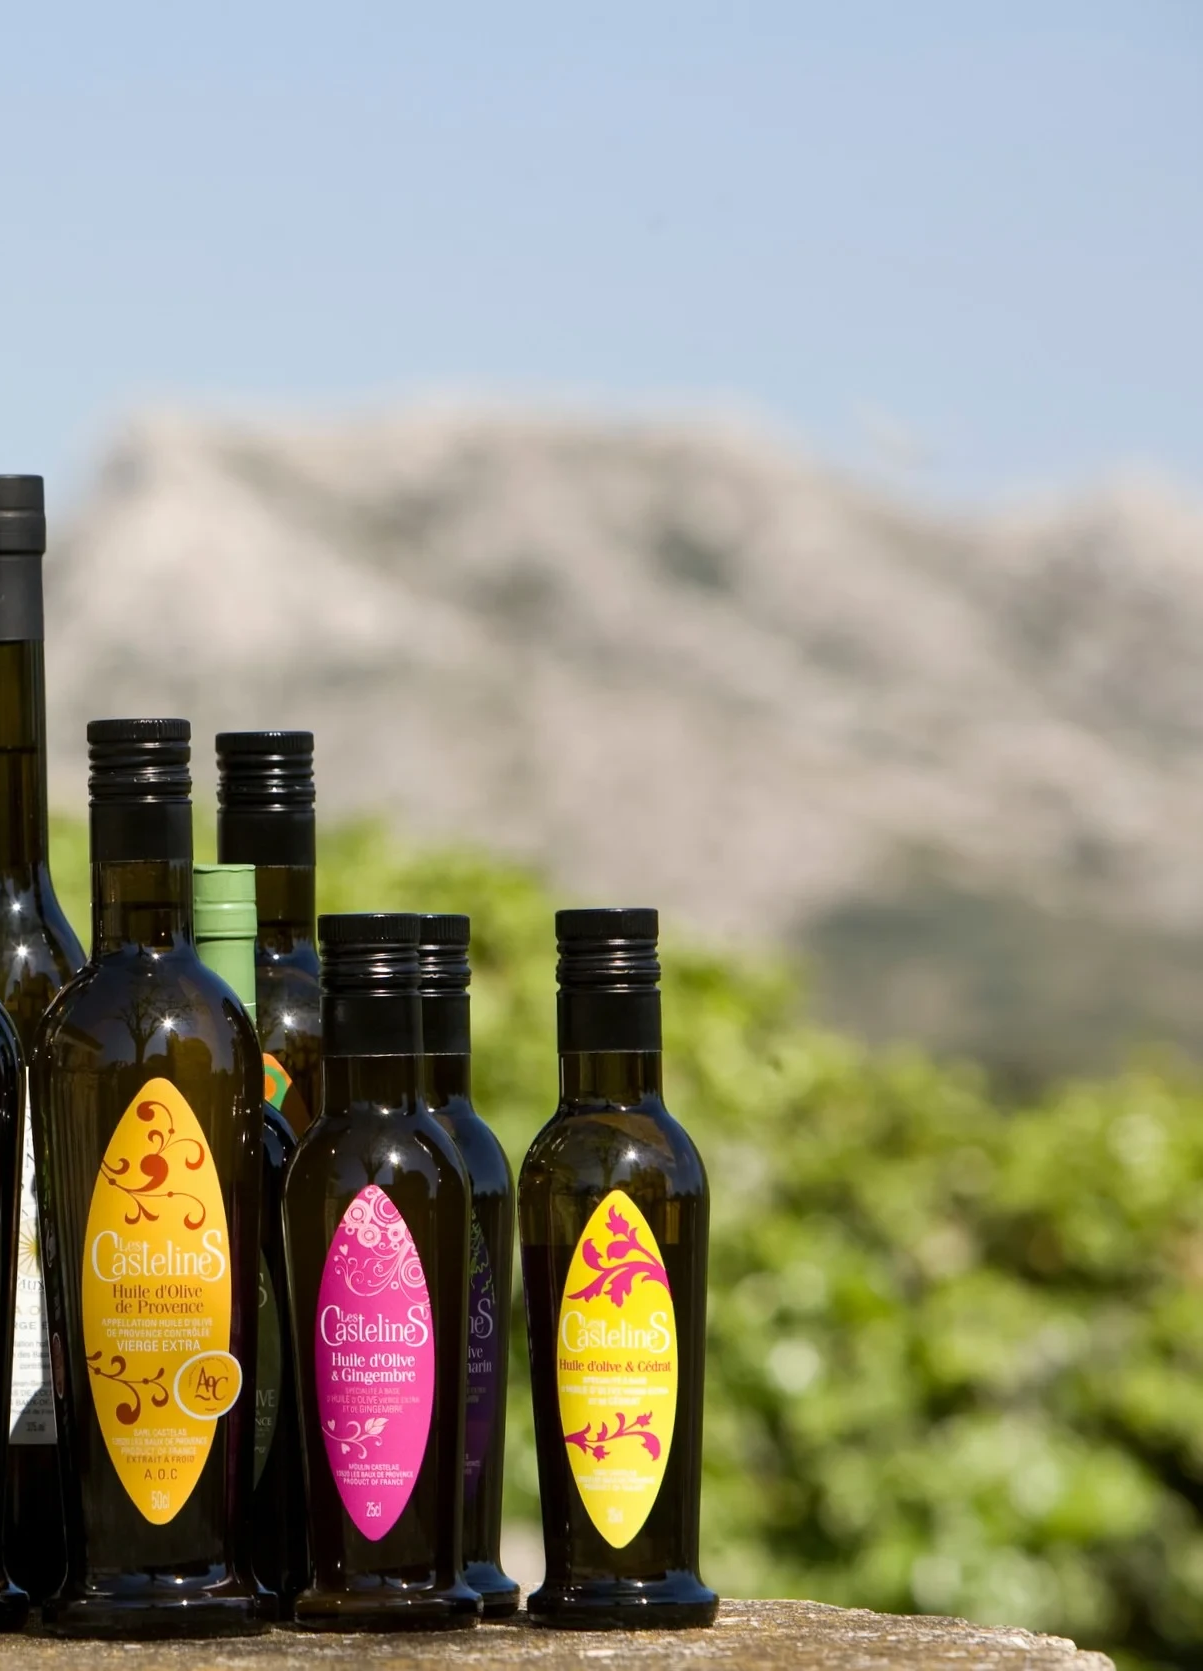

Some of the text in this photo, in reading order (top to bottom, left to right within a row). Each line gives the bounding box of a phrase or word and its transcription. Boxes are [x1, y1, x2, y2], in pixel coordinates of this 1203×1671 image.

[112, 1284, 202, 1300] Huile d'Olive
[116, 1300, 204, 1314] de Provence
[341, 1310, 358, 1323] Les
[117, 1340, 202, 1352] VIERGE EXTRA
[332, 1352, 416, 1368] Huile d'Olive
[559, 1358, 672, 1372] Huile d'olive & Cédrat
[332, 1368, 416, 1386] & Gingembre
